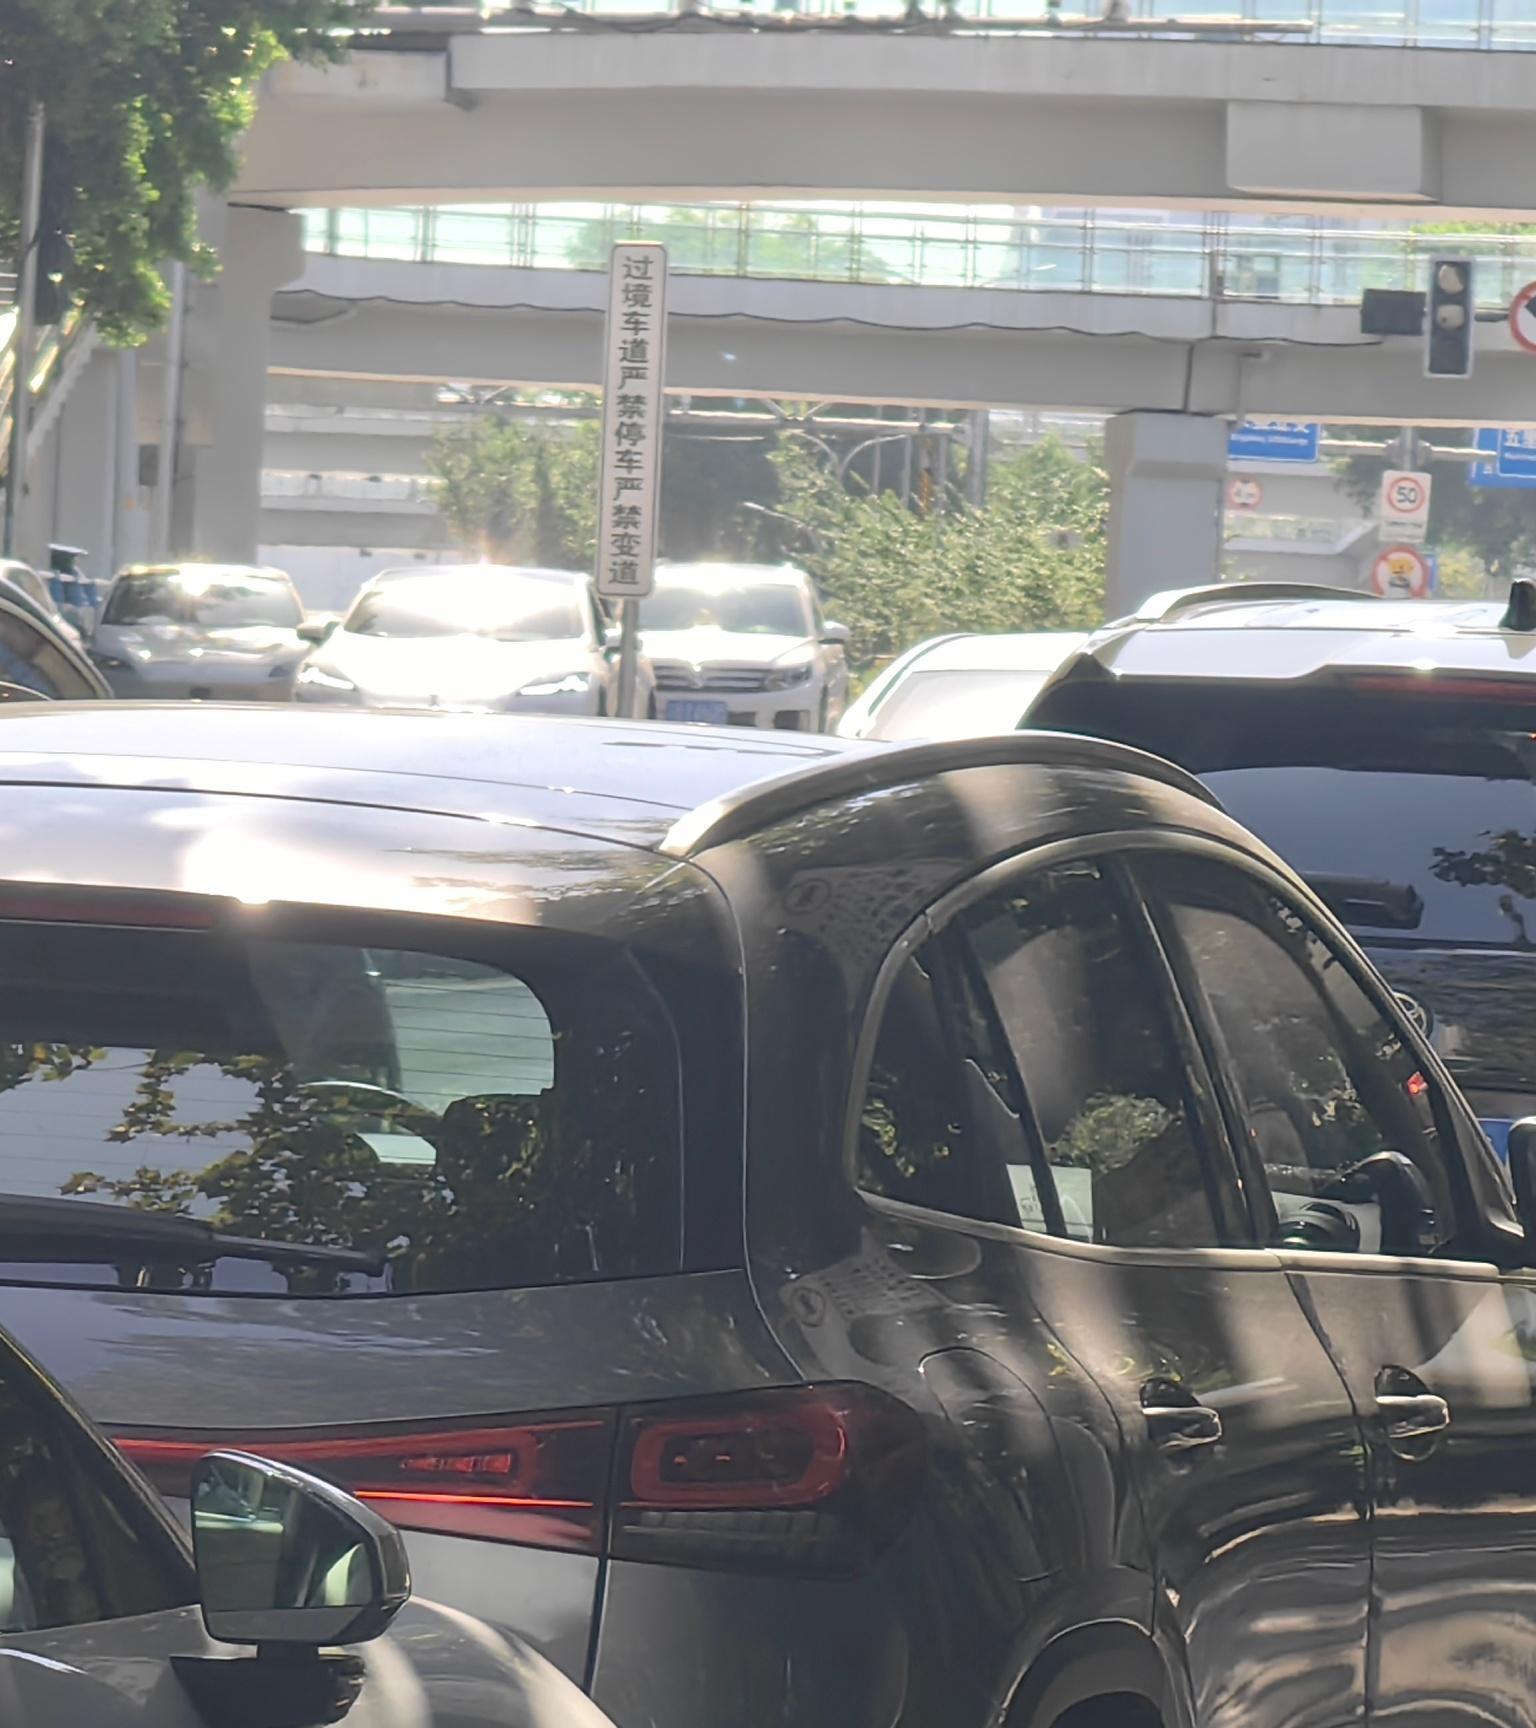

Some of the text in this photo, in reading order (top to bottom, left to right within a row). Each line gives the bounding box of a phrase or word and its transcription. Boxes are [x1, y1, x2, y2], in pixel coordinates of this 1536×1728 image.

[608, 255, 654, 586] 过境车道严禁停车严禁变道
[1396, 485, 1418, 504] 50
